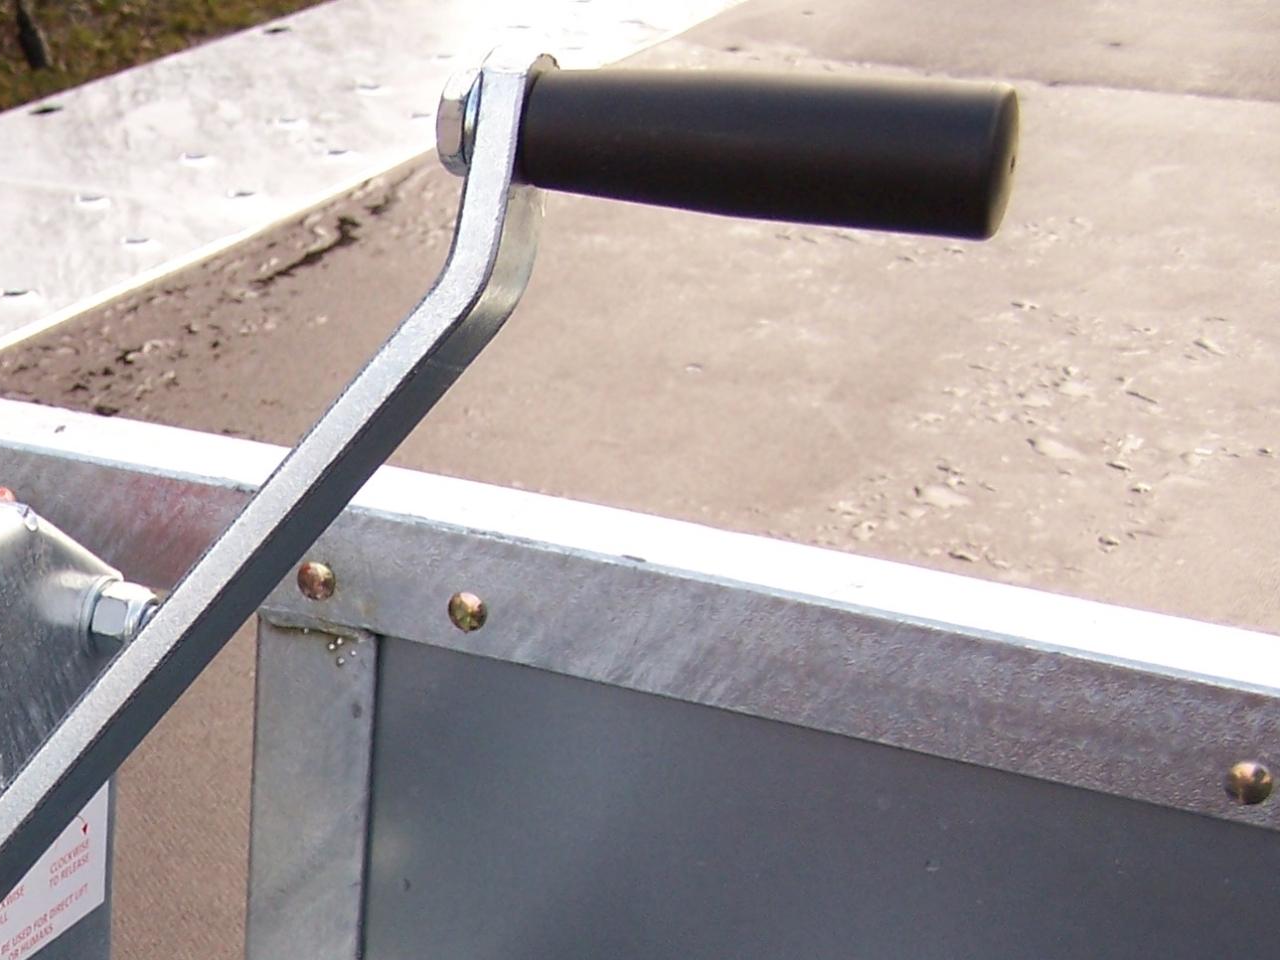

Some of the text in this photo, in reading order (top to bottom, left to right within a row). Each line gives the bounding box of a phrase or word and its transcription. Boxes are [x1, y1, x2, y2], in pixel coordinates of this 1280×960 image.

[48, 852, 89, 889] TO RELEASE
[1, 941, 11, 956] BE
[12, 926, 32, 947] USED
[33, 912, 48, 932] FOR
[49, 894, 74, 919] DIRECT
[74, 883, 88, 901] LIFT
[20, 923, 53, 953] HUMANS
